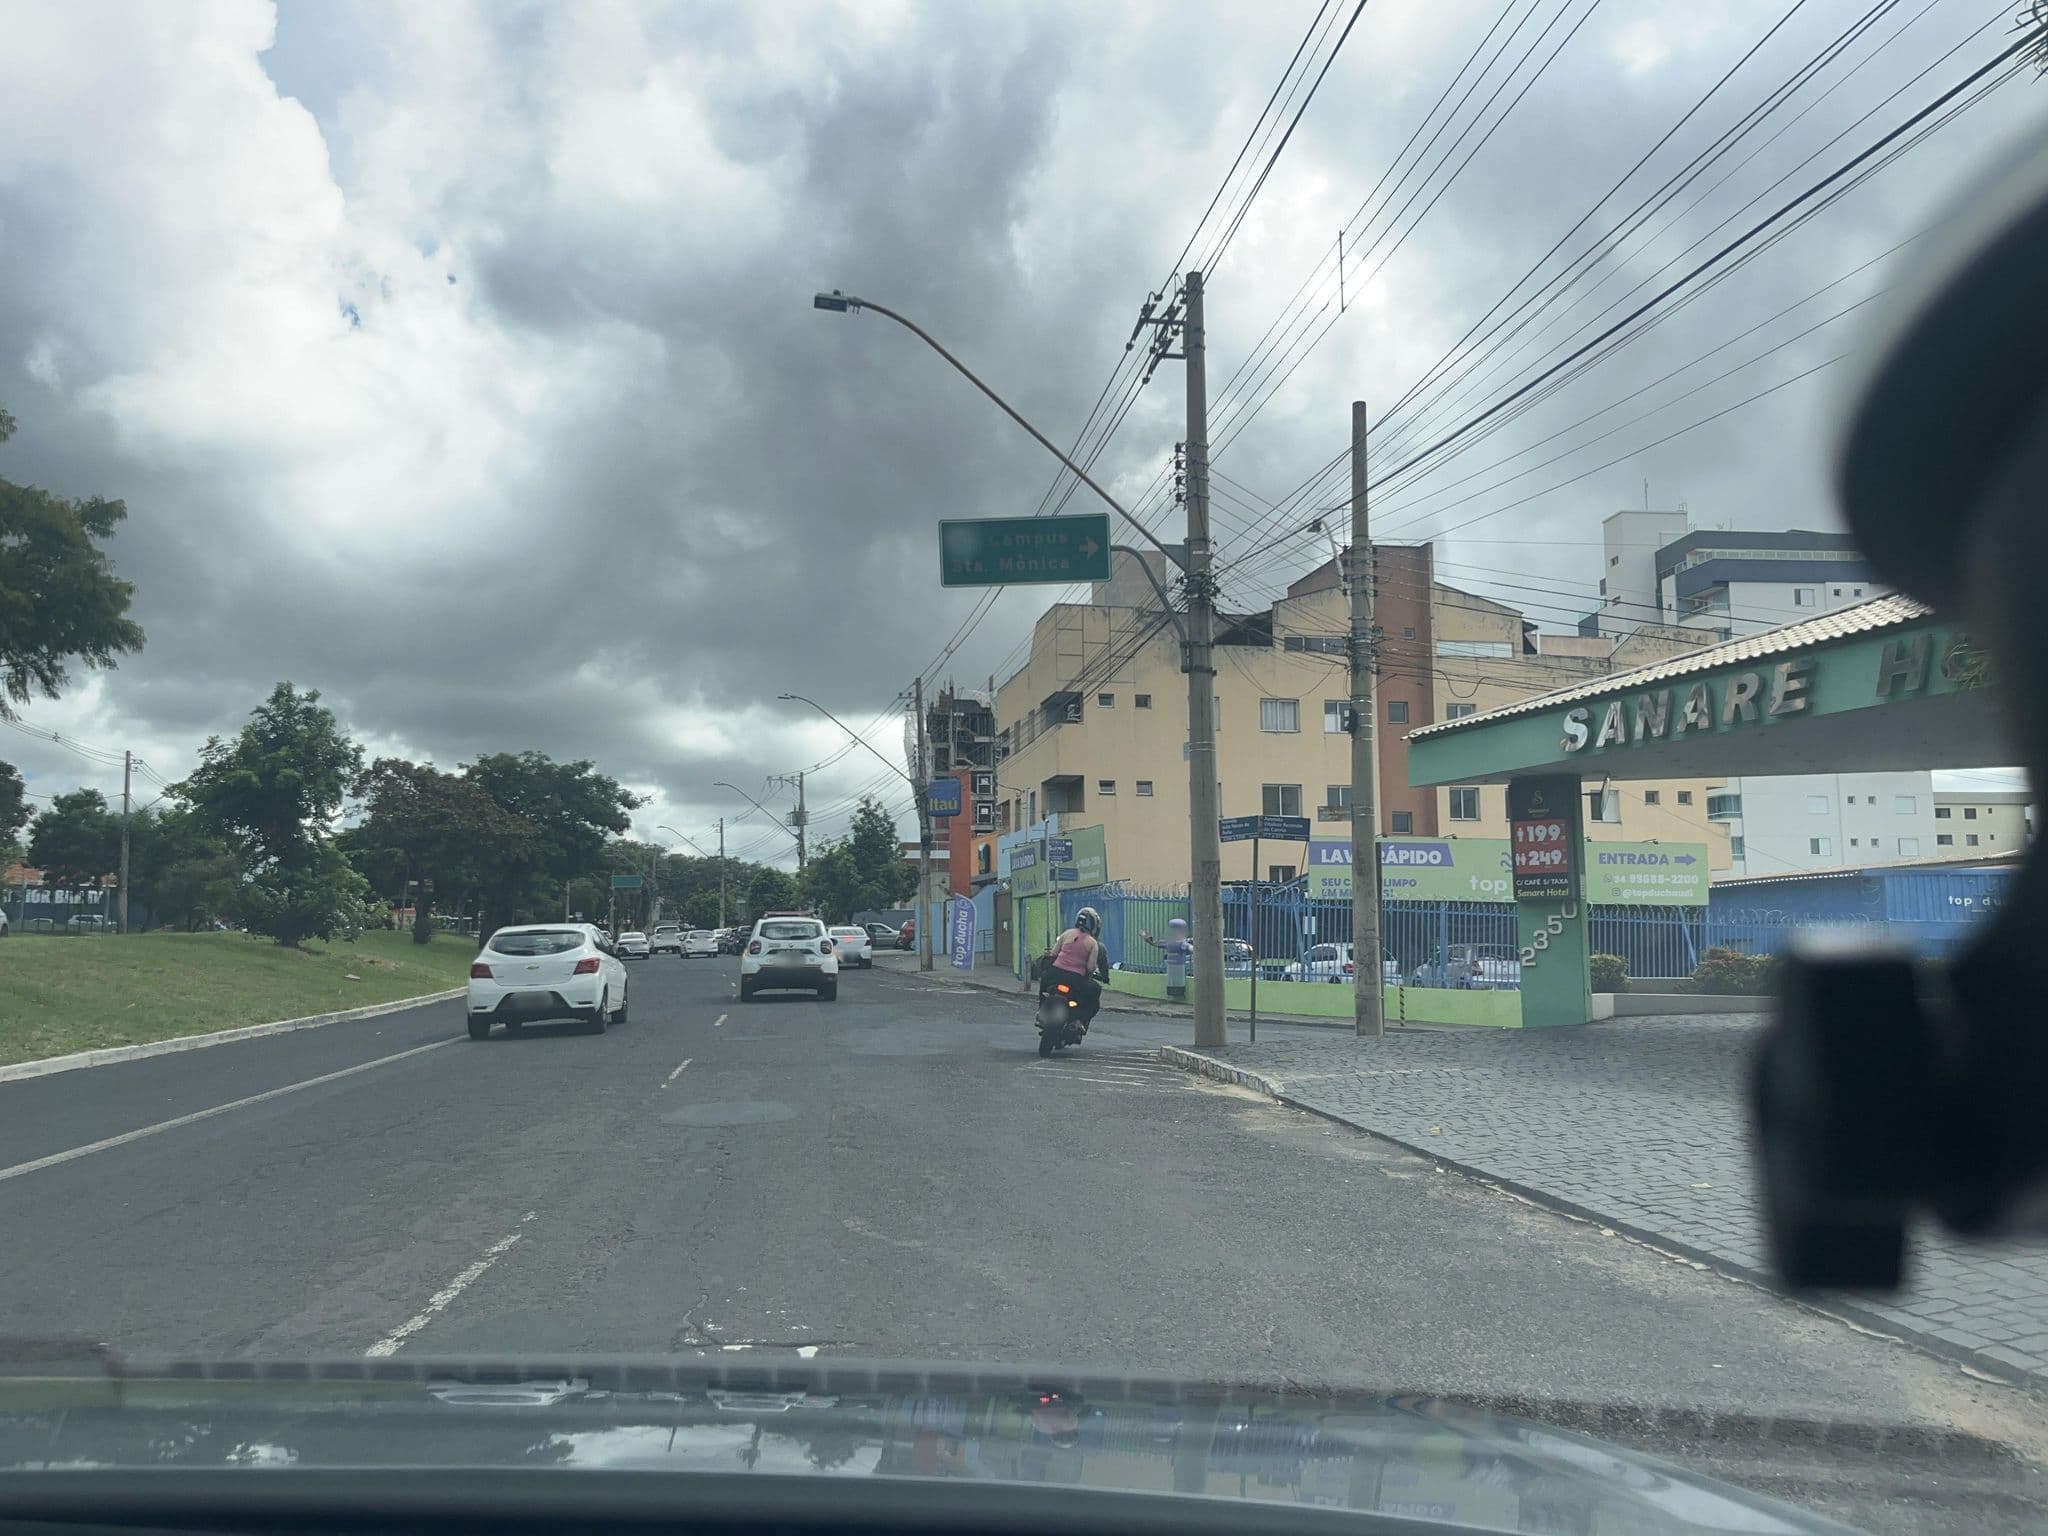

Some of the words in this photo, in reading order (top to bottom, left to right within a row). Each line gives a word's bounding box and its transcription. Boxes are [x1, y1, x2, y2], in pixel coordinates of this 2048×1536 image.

[1560, 658, 1815, 752] SANARE
[929, 796, 957, 811] Itaú
[1526, 825, 1560, 842] 199
[1321, 848, 1352, 863] LAV
[1528, 849, 1562, 866] 249
[1599, 853, 1669, 865] ENTRADA
[1321, 878, 1341, 887] SEU
[1384, 878, 1417, 887] LIMPO
[1469, 875, 1507, 895] top
[1517, 889, 1545, 897] Sanare
[1546, 888, 1569, 896] Hotel
[1948, 895, 1973, 907] top
[953, 946, 967, 966] top
